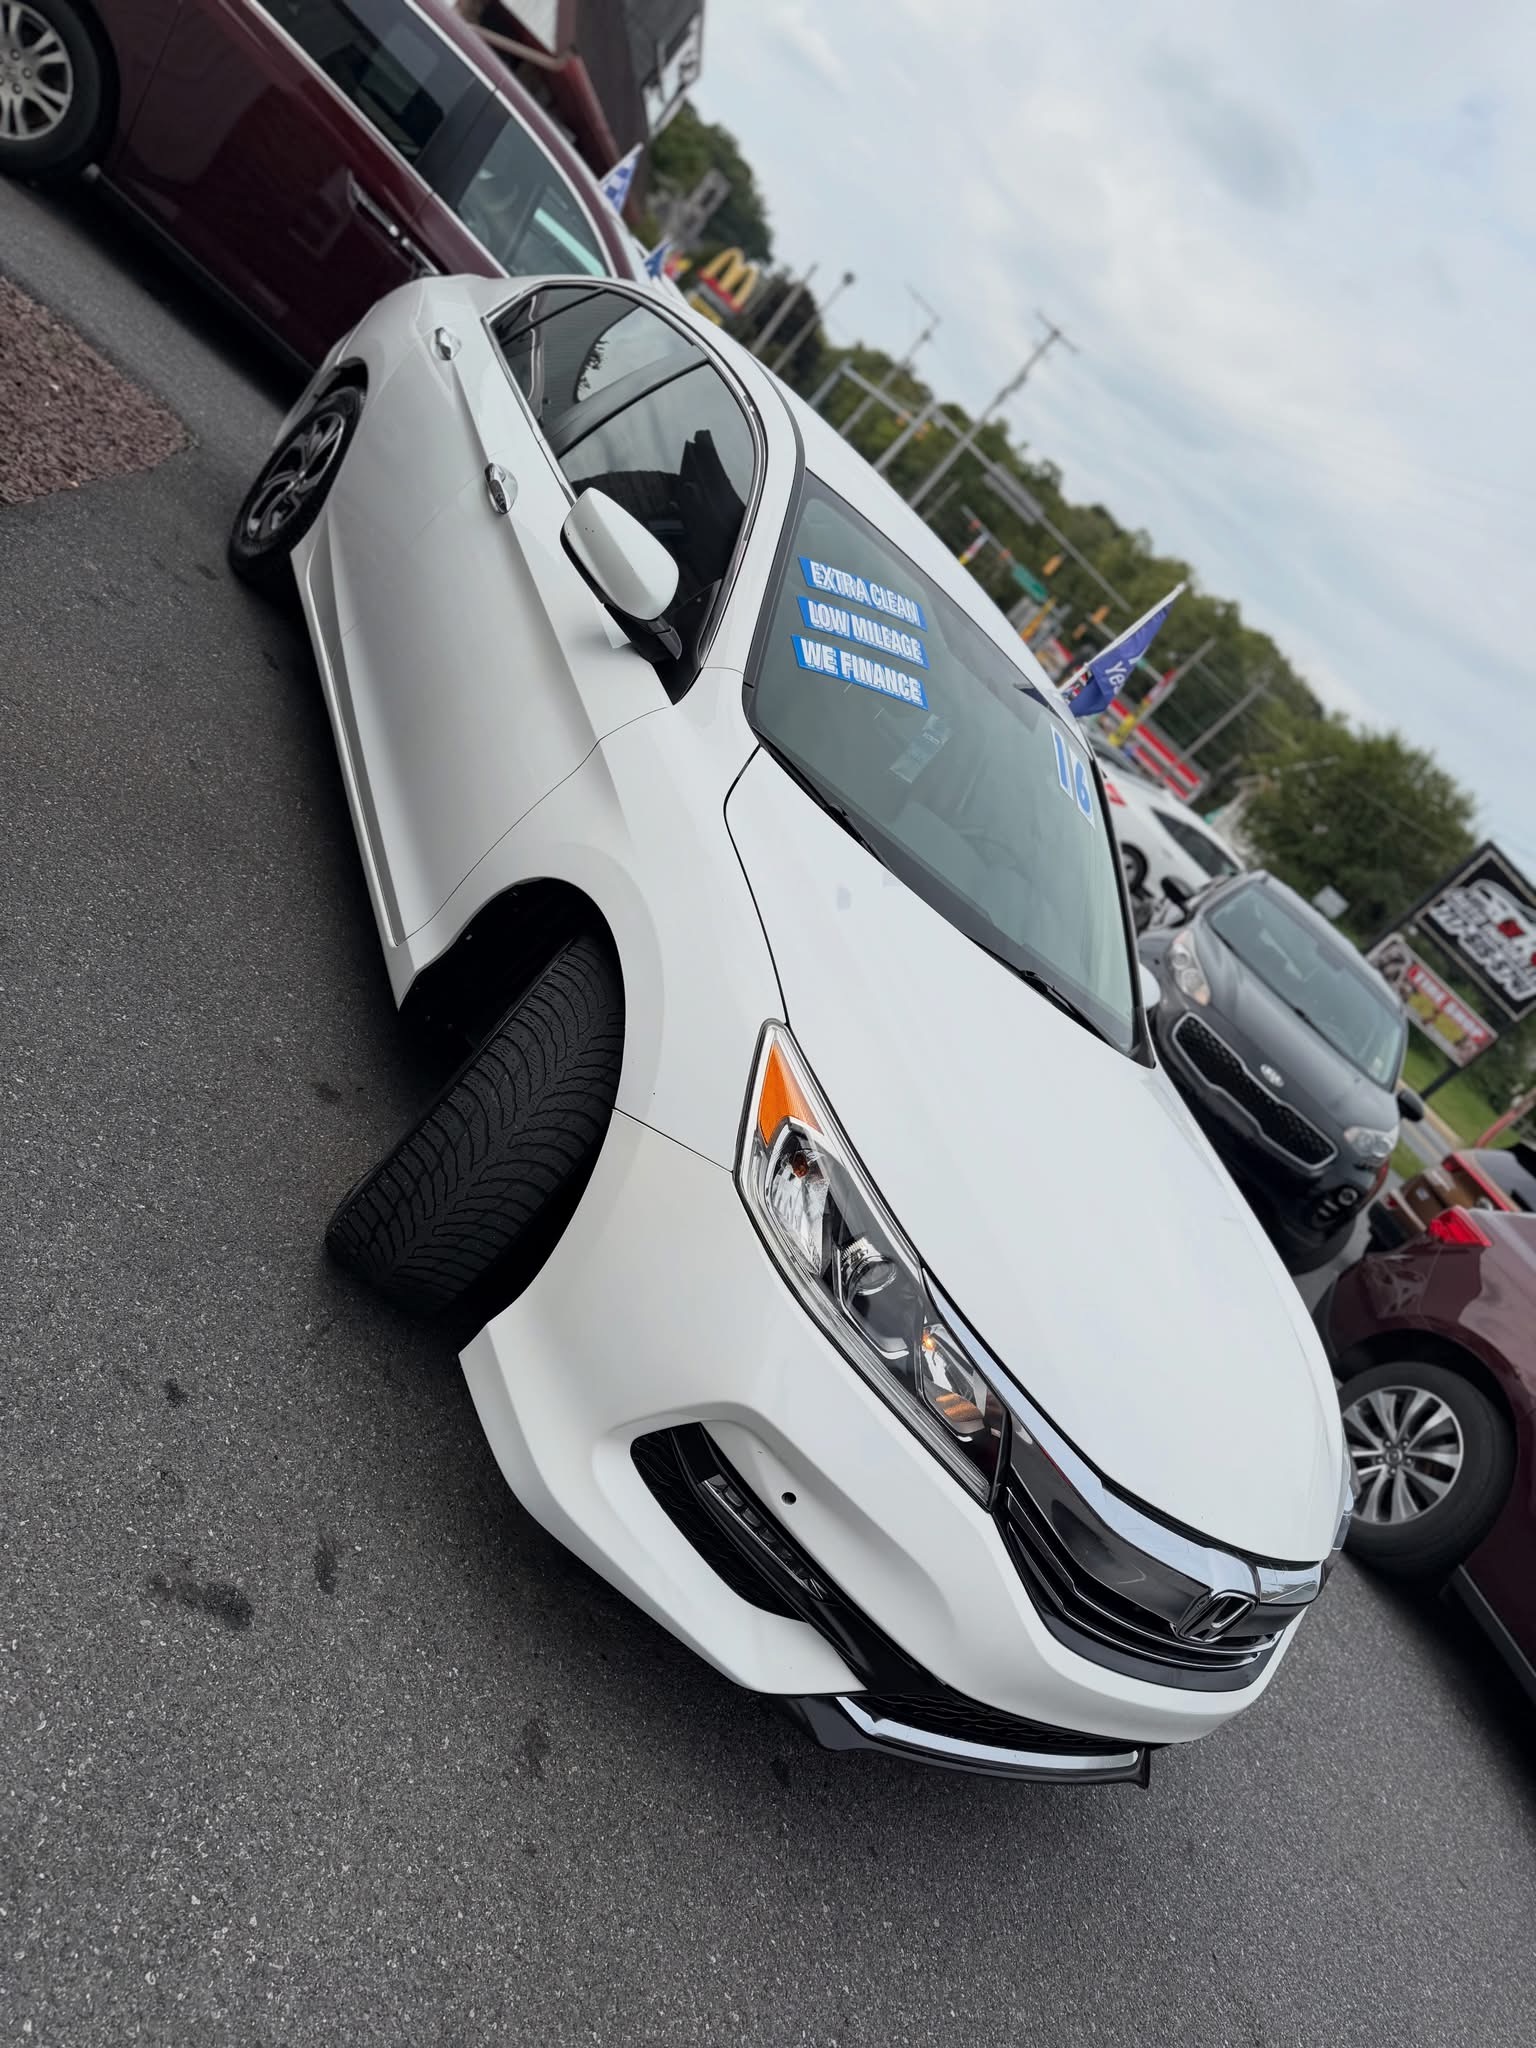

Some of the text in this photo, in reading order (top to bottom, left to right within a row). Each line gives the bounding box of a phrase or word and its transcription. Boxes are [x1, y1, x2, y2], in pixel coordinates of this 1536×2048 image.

[809, 561, 921, 626] EXTRA CLEAN
[808, 600, 923, 664] LOW MILEAGE
[800, 638, 923, 706] WE FINANCE
[1052, 728, 1093, 820] 16
